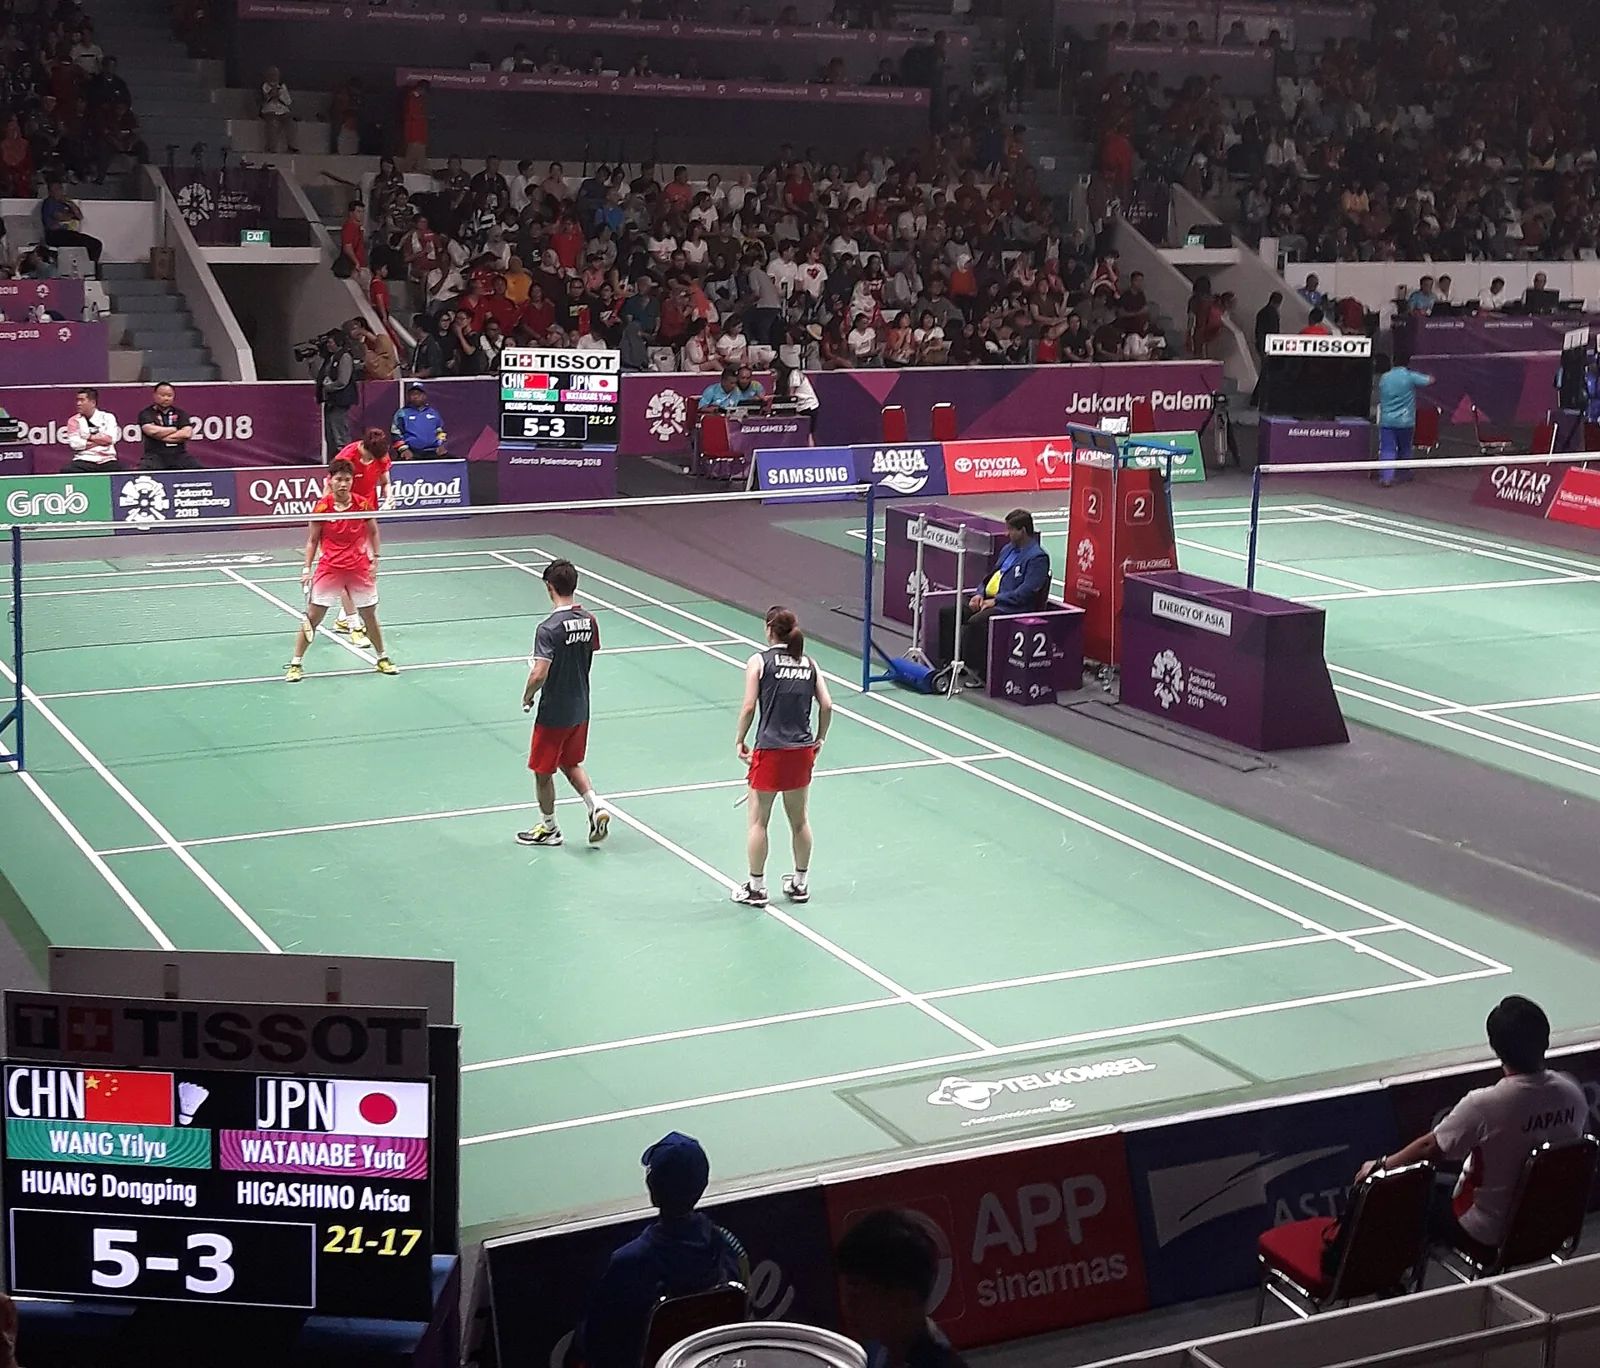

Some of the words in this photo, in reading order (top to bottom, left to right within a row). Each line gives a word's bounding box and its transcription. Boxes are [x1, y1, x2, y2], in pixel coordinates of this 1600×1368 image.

[1300, 340, 1369, 353] TISSOT
[535, 354, 616, 370] TISSOT
[502, 373, 525, 389] CHN
[570, 374, 591, 390] JPN
[189, 415, 253, 440] 2018
[523, 418, 565, 437] 5-3
[588, 415, 616, 425] 21-17
[872, 449, 929, 473] AQUA
[972, 457, 1020, 470] TOYOTA
[768, 467, 848, 484] SAMSUNG
[1491, 465, 1551, 492] QATAR
[6, 484, 89, 517] Grab
[173, 489, 213, 498] Jakarta
[173, 497, 230, 508] Palembang
[249, 477, 328, 505] QATA
[174, 508, 200, 518] 2018
[273, 500, 317, 515] AIRW
[1087, 494, 1097, 515] 2
[1133, 497, 1145, 518] 2
[1159, 599, 1191, 618] ENERGY
[1192, 608, 1203, 621] OF
[1205, 613, 1225, 629] ASIA
[1012, 631, 1025, 657] 2
[1032, 632, 1047, 658] 2
[774, 667, 812, 680] JAPAN
[122, 1007, 421, 1065] TISSOT
[1000, 1057, 1158, 1093] TELKOMSEL
[7, 1067, 85, 1119] CHN
[259, 1079, 334, 1131] JPN
[1522, 1106, 1574, 1133] JAPAN
[49, 1130, 113, 1154] WANG
[117, 1134, 168, 1164] Yilyu
[240, 1139, 357, 1168] WATANABE
[361, 1146, 407, 1171] Yuta
[21, 1170, 97, 1197] HUANG
[101, 1174, 197, 1207] Dongping
[237, 1180, 355, 1210] HIGASHINO
[359, 1187, 411, 1213] Arisa
[971, 1173, 1108, 1264] APP
[323, 1224, 423, 1257] 21-17
[91, 1228, 236, 1294] 5-3
[977, 1251, 1129, 1308] sinarmas
